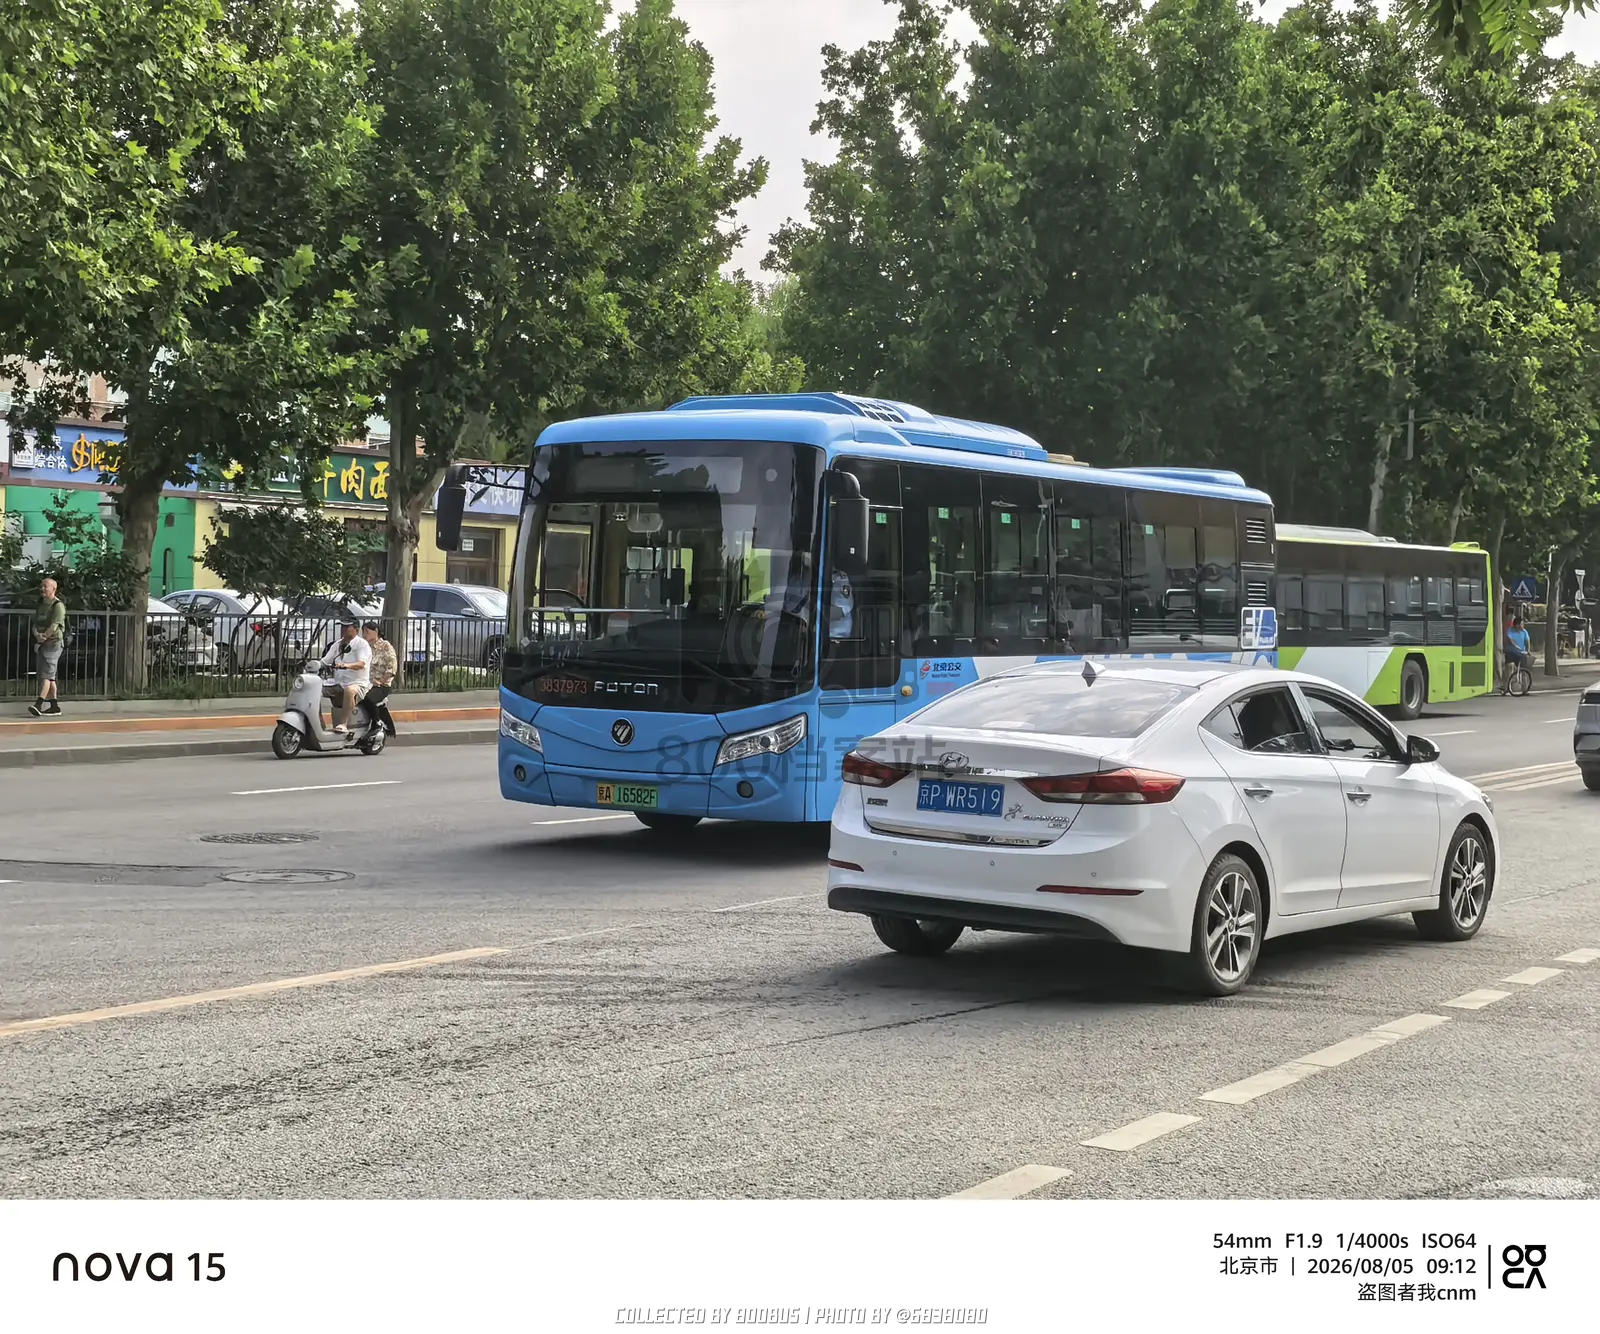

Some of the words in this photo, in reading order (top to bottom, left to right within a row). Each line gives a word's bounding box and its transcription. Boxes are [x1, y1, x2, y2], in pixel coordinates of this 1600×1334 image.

[35, 453, 67, 469] 综合体
[933, 662, 962, 672] 北京公交
[540, 678, 587, 694] 3837973
[593, 680, 659, 695] FOTON
